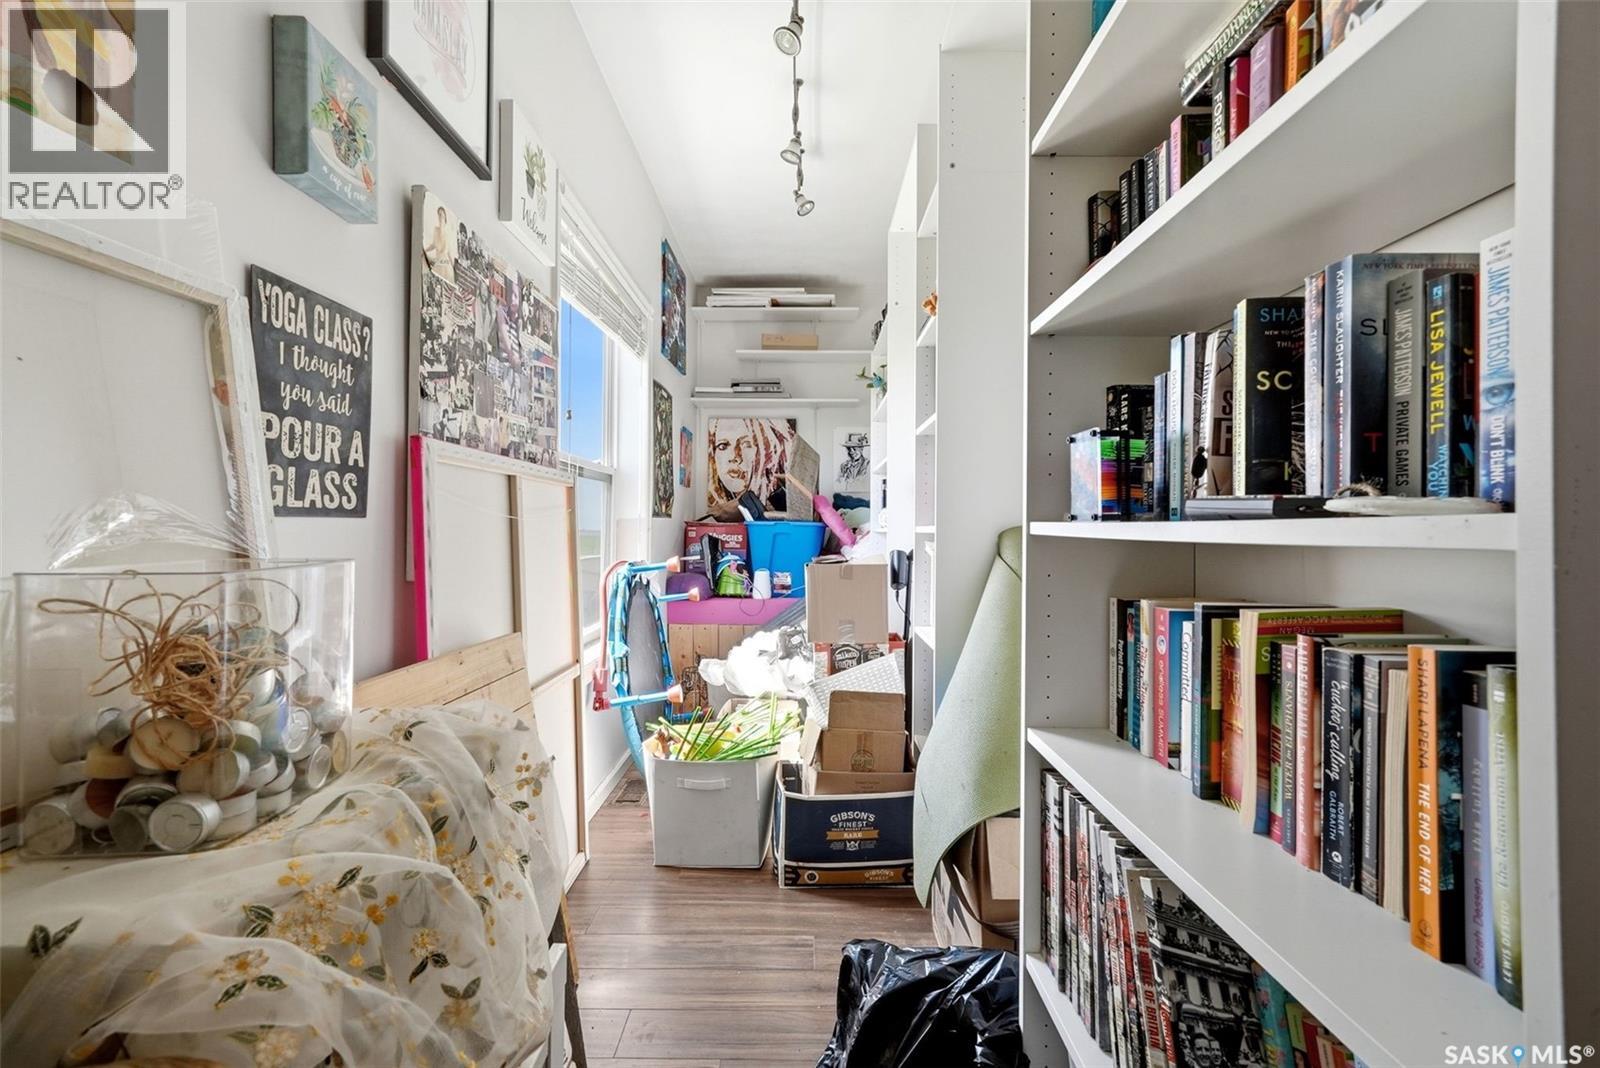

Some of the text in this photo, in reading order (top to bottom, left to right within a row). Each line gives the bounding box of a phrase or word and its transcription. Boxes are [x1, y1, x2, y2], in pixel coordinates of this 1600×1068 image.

[1335, 269, 1345, 308] KARIN
[1487, 265, 1511, 308] JAMES
[257, 278, 371, 361] YOGA CLASS?
[1394, 308, 1413, 342] JAMES
[1486, 306, 1510, 378] PATTERSON
[278, 341, 355, 388] I thought
[1335, 312, 1344, 384] SLAUGHTER
[1394, 340, 1413, 397] PATTERSON
[279, 381, 352, 416] you said
[1428, 308, 1449, 500] LISA JEWELL WATCHIN
[260, 411, 365, 467] POUR A
[1396, 400, 1410, 446] PRIVATE
[267, 463, 358, 511] GLASS
[1395, 447, 1410, 487] GAMES
[1490, 448, 1505, 484] BLINK
[1181, 632, 1193, 702] Committed
[1157, 659, 1166, 758] endless SUMMER
[1284, 680, 1294, 749] ELEPHANTS
[1325, 731, 1344, 782] calling
[1417, 657, 1431, 896] SHARI LAPENA THE END OF HER
[1284, 763, 1294, 801] WATER
[830, 811, 876, 823] GIBSON'S
[1328, 790, 1337, 841] GALBRAITH
[1337, 801, 1345, 836] ROBERT
[1472, 878, 1484, 927] Dessen
[1136, 930, 1148, 950] THE
[1472, 930, 1485, 969] Sarah
[1501, 947, 1513, 984] LEWIS
[1144, 989, 1156, 1005] OF
[1146, 1006, 1161, 1050] BRITAIN
